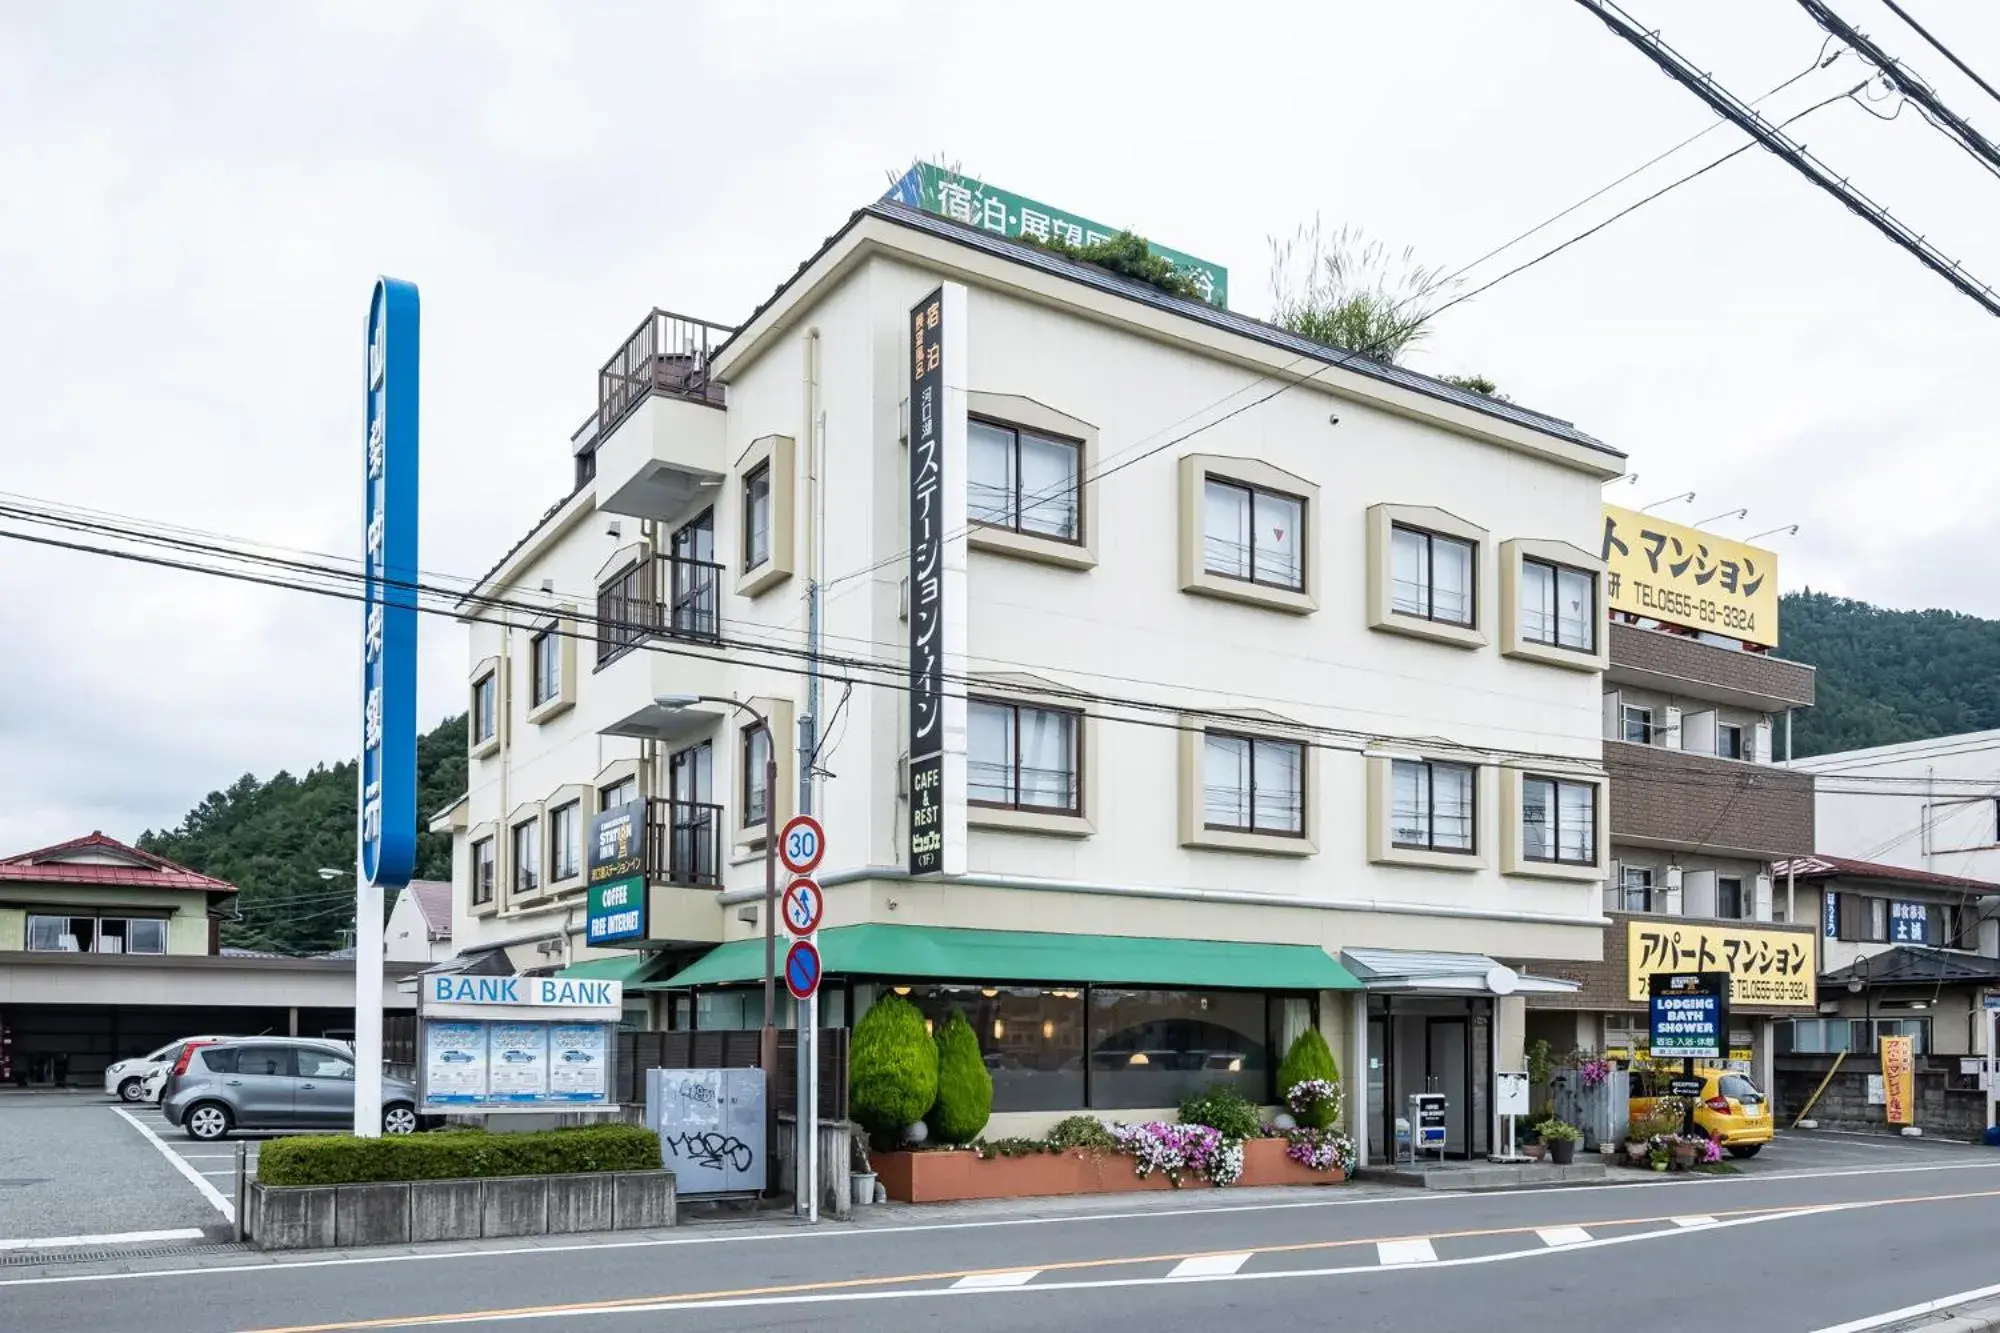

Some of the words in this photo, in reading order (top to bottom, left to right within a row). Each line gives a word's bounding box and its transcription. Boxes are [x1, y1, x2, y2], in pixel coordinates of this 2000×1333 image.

[927, 303, 940, 371] 宿泊
[914, 769, 939, 791] CAFE
[922, 790, 930, 806] &
[914, 805, 939, 827] REST
[788, 831, 815, 860] 30
[602, 885, 628, 908] COFFEE
[591, 917, 607, 937] FREE
[607, 910, 640, 935] INTERNET
[436, 977, 519, 1002] BANK
[542, 980, 612, 1004] BANK
[1656, 998, 1714, 1010] LODGING
[1667, 1010, 1704, 1021] BATH
[1657, 1022, 1714, 1034] SHOWER
